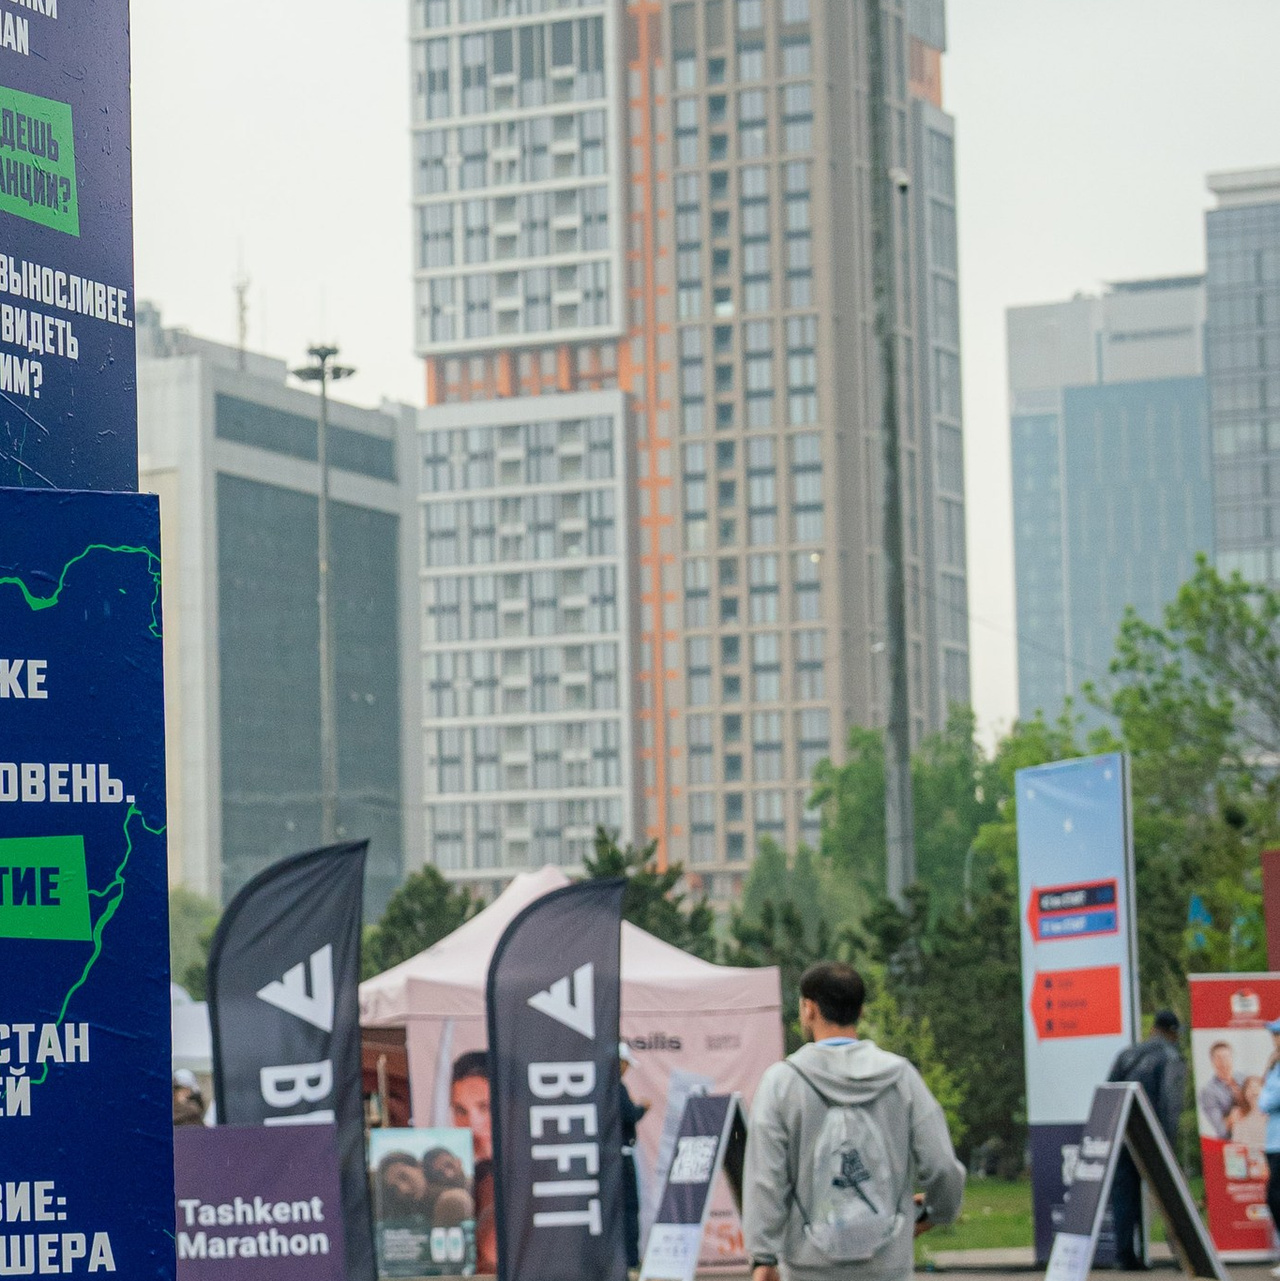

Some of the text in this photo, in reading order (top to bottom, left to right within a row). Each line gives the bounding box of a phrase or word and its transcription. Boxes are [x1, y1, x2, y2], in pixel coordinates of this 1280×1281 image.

[528, 1060, 602, 1237] BEFIT
[177, 1195, 326, 1227] Tashkent
[177, 1227, 330, 1260] Marathon
